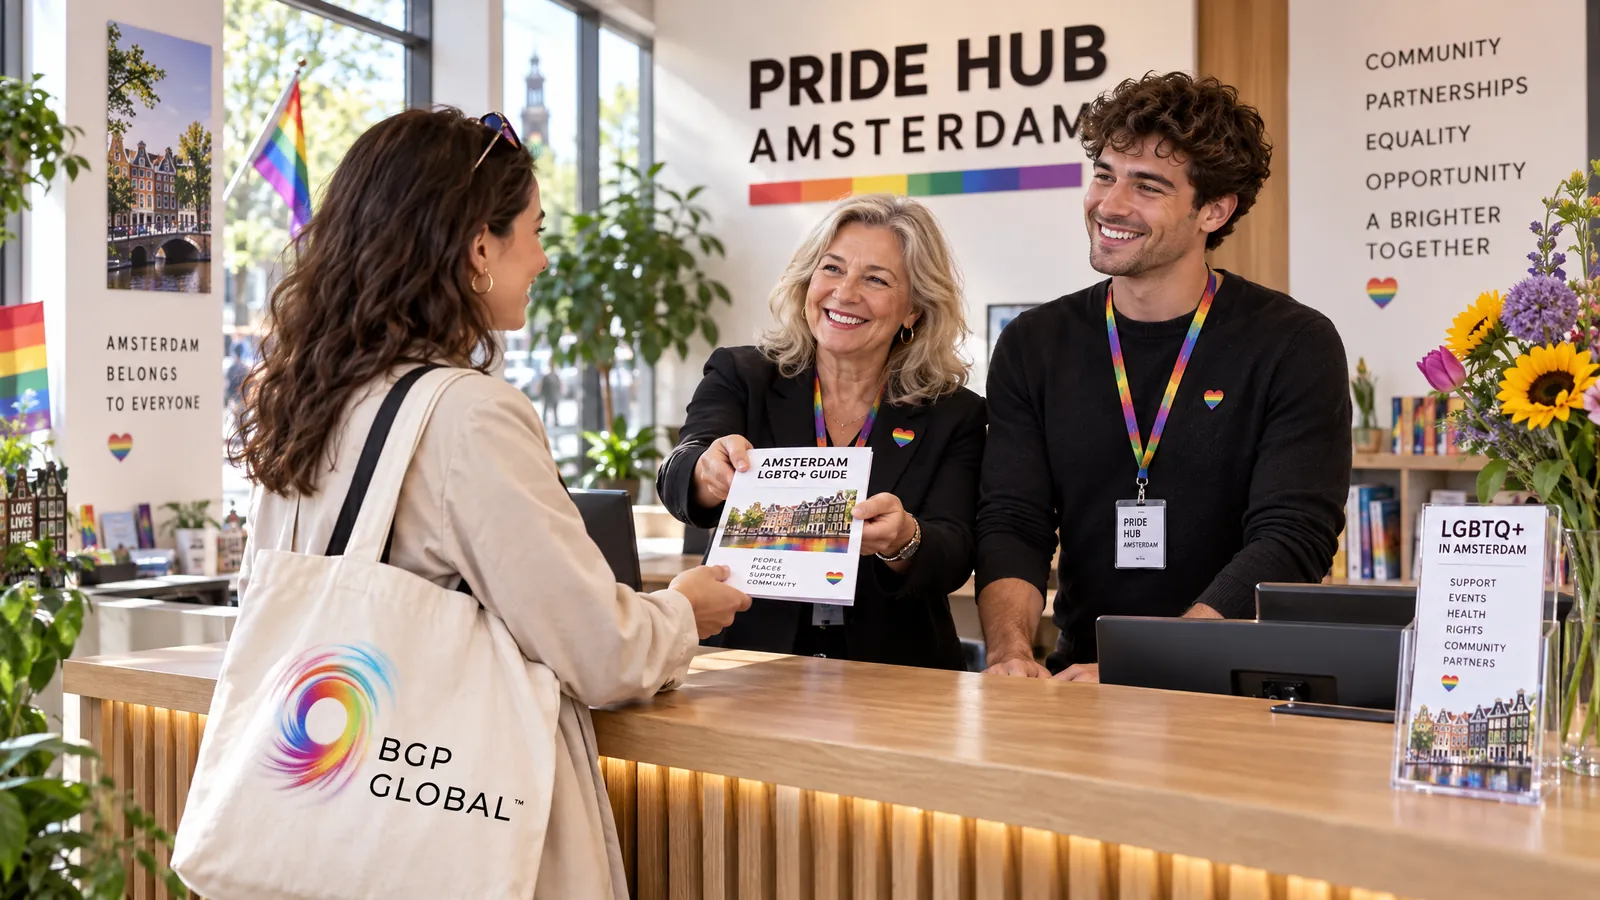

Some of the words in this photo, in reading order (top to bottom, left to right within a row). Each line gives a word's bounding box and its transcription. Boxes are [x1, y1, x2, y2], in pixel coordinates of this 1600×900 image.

[1365, 36, 1501, 71] COMMUNITY
[749, 42, 928, 111] PRIDE
[957, 24, 1107, 91] HUB
[1366, 76, 1528, 111] PARTNERSHIPS
[749, 102, 1091, 163] AMSTERDAM
[1366, 124, 1471, 151] EQUALITY
[1365, 161, 1526, 191] OPPORTUNITY
[1366, 212, 1380, 230] A
[1390, 205, 1501, 229] BRIGHTER
[1366, 237, 1490, 260] TOGETHER
[106, 335, 199, 352] AMSTERDAM
[106, 365, 177, 382] BELONGS
[106, 396, 125, 412] TO
[131, 395, 200, 411] EVERYONE
[761, 457, 849, 468] AMSTERDAM
[757, 469, 807, 480] LGBTQ+
[809, 469, 848, 480] GUIDE
[10, 502, 33, 514] LOVE
[10, 516, 33, 529] LIVES
[1123, 517, 1148, 527] PRIDE
[1123, 529, 1141, 539] HUB
[1442, 519, 1524, 540] LGBTQ+
[10, 530, 32, 543] HERE
[1123, 541, 1159, 549] AMSTERDAM
[1438, 543, 1451, 554] IN
[1453, 543, 1527, 555] AMSTERDAM
[748, 571, 786, 580] SUPPORT
[746, 579, 797, 588] COMMUNITY
[1449, 577, 1497, 588] SUPPORT
[1448, 593, 1487, 604] EVENTS
[1447, 609, 1486, 619] HEALTH
[1445, 624, 1483, 635] RIGHTS
[1444, 640, 1507, 653] COMMUNITY
[1443, 656, 1496, 668] PARTNERS
[378, 736, 453, 770] BGP
